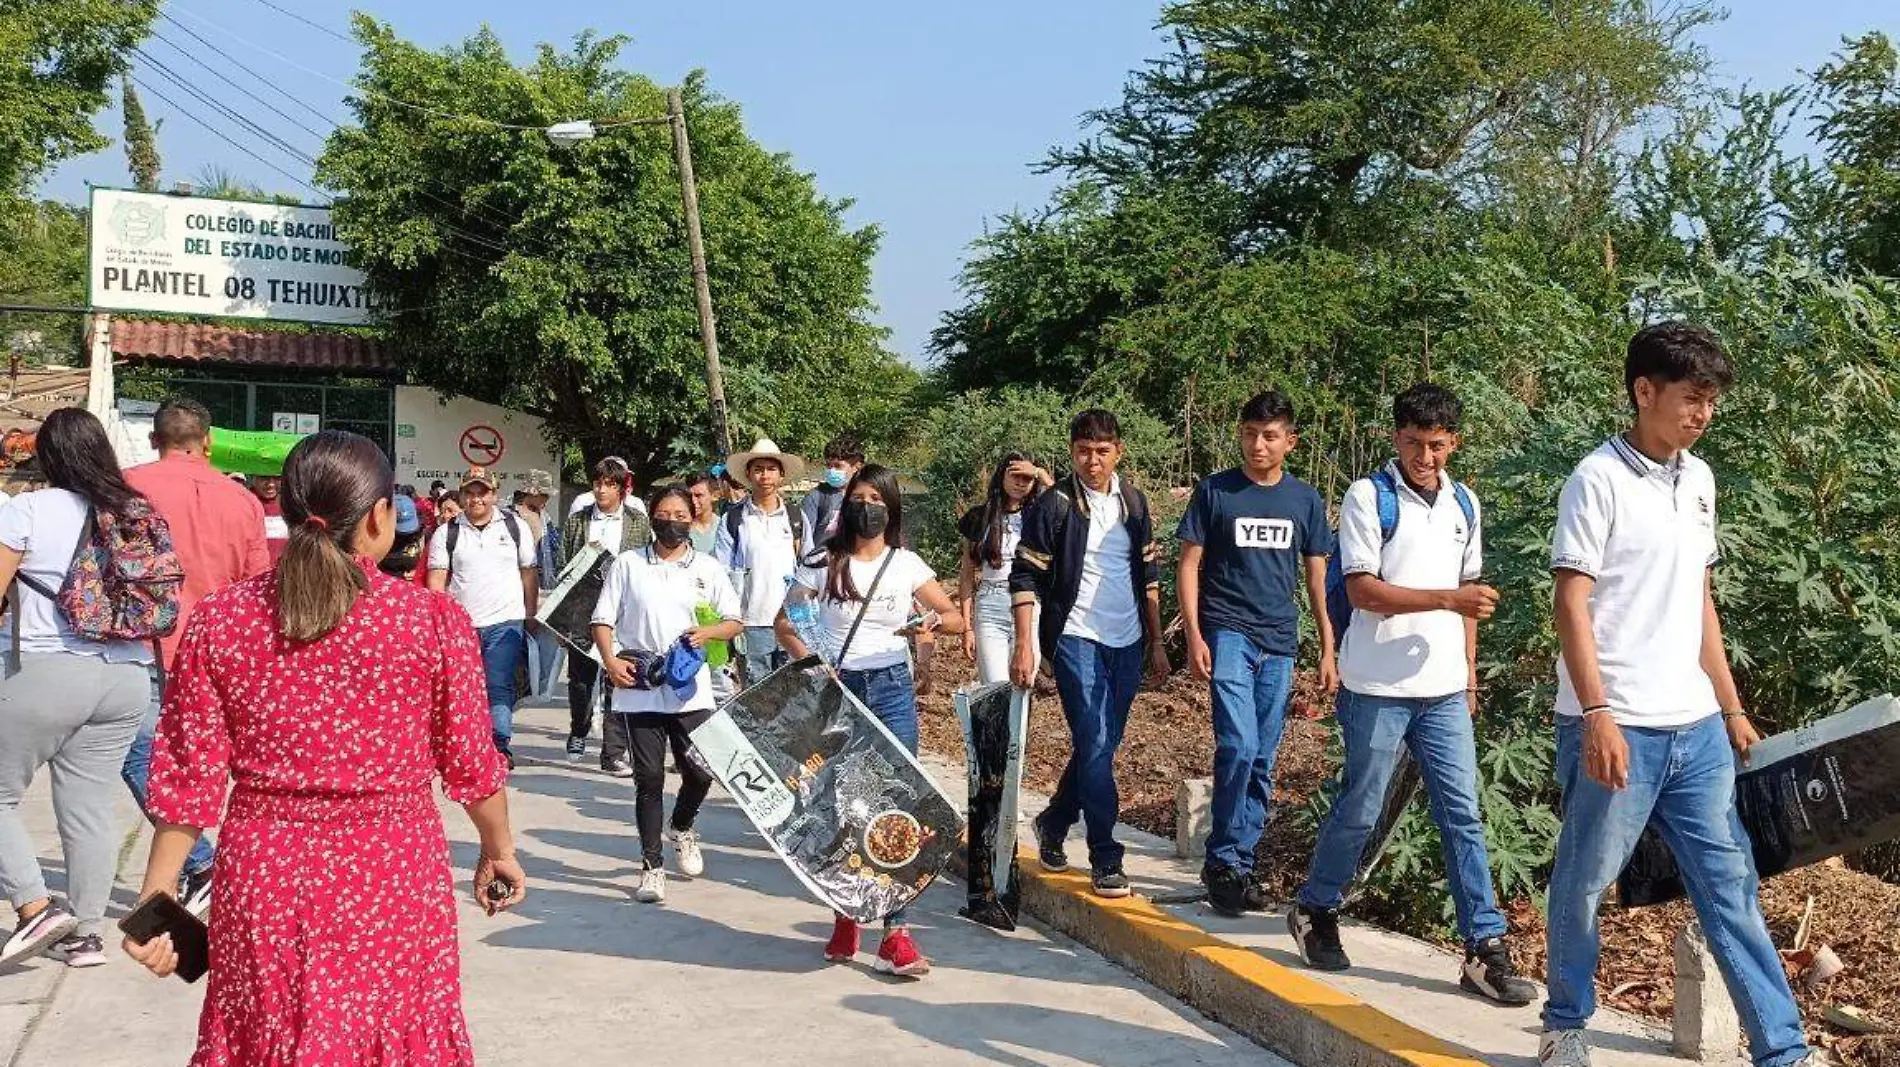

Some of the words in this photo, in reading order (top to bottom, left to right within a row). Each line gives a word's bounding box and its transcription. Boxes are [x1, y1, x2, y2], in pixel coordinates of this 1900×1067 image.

[186, 214, 255, 234] COLEGIO
[260, 220, 278, 236] DE
[283, 222, 340, 241] BACHIL
[184, 237, 212, 255] DEL
[220, 241, 288, 260] ESTADO
[292, 246, 312, 263] DE
[103, 266, 211, 298] PLANTEL
[224, 276, 255, 299] 08
[1241, 524, 1288, 543] YETI
